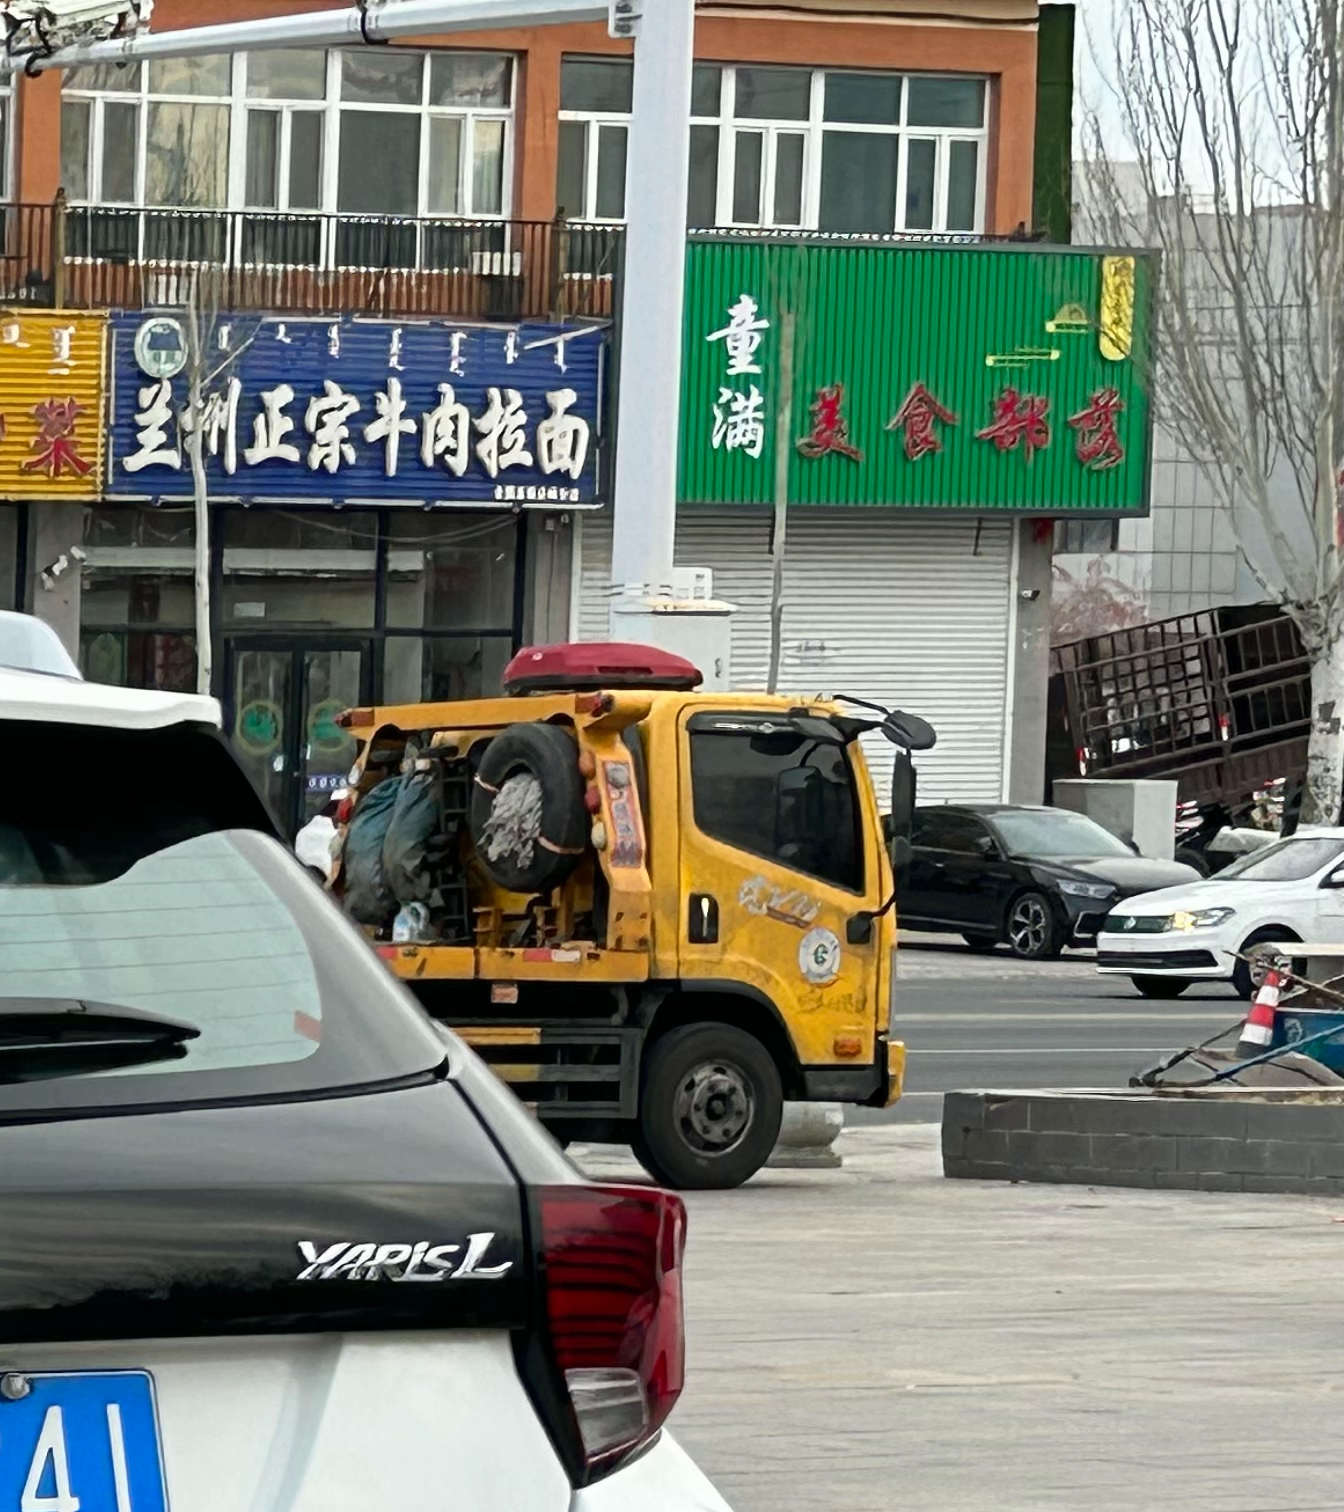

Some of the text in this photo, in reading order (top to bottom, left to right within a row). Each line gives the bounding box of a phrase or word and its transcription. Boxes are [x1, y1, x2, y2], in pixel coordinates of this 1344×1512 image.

[121, 376, 591, 480] 兰州正宗牛肉拉面
[706, 294, 771, 460] 童满
[796, 383, 1128, 472] 美食部落
